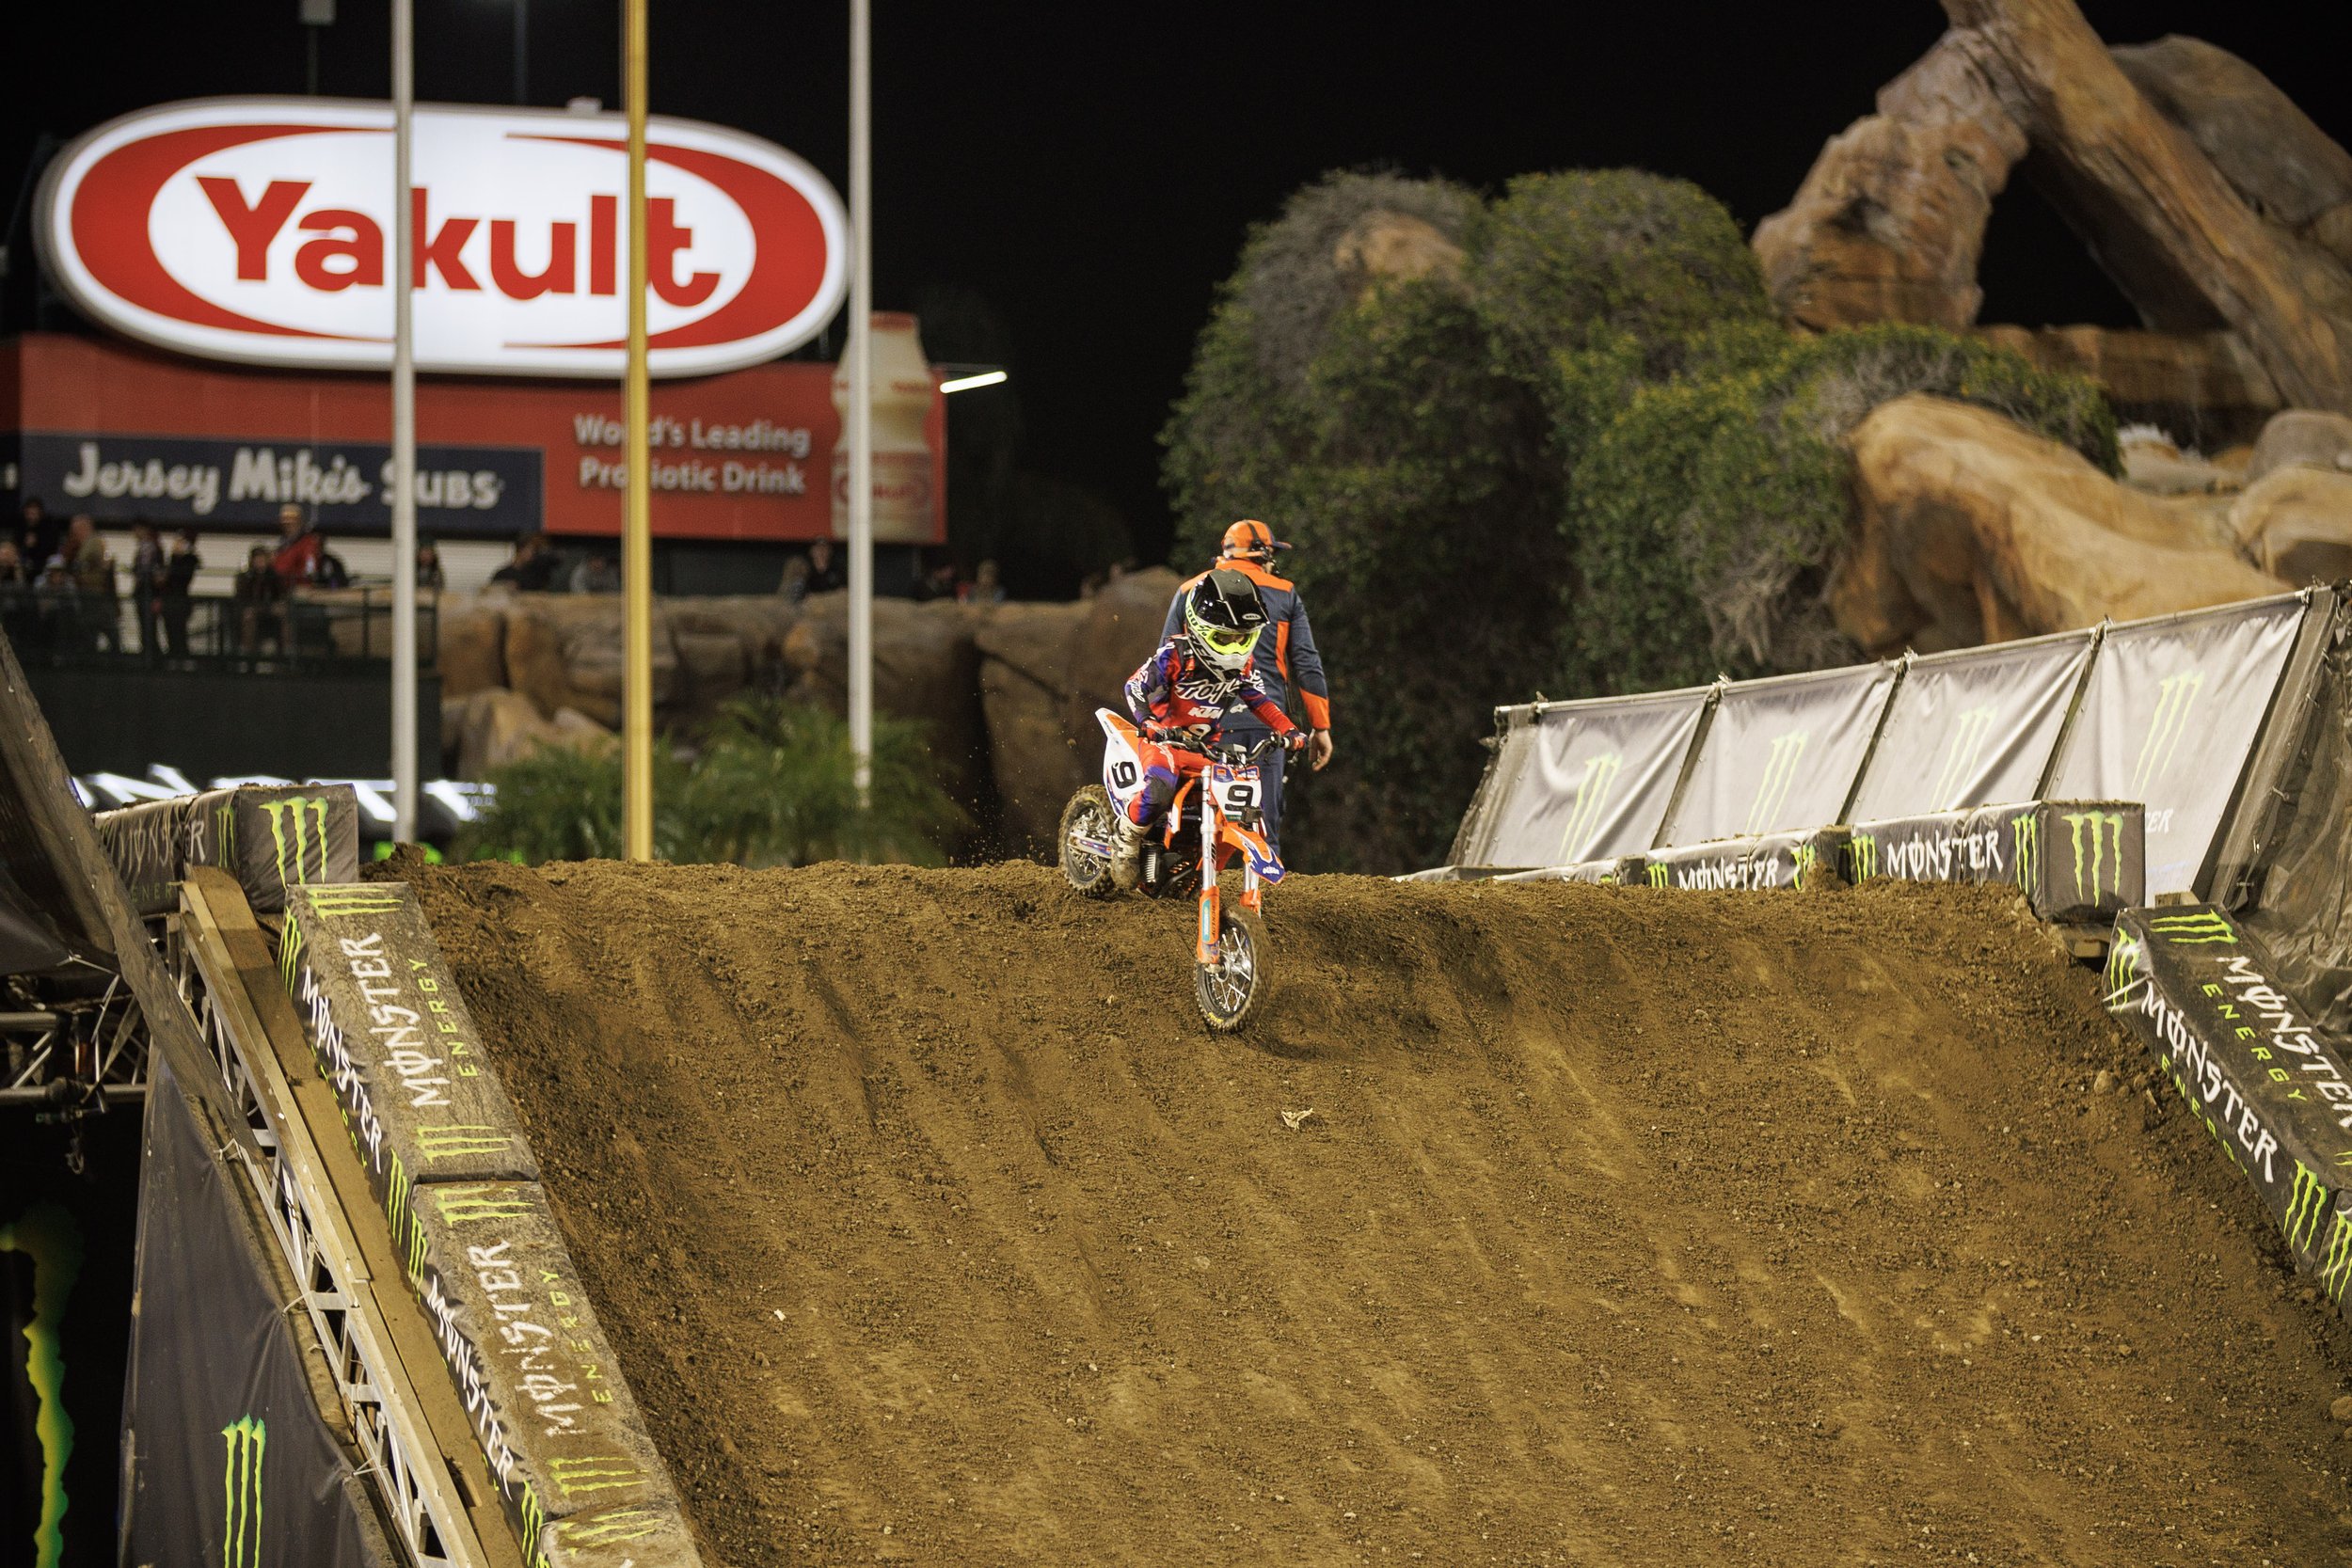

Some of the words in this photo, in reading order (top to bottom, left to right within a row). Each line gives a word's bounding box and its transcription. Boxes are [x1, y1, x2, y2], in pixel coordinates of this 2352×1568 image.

[196, 176, 721, 308] Yakult
[573, 414, 685, 448] Wod's
[691, 419, 812, 459] Leading
[64, 442, 220, 515] Jersey
[229, 447, 372, 503] Mike's
[580, 456, 716, 492] Proiotic
[722, 460, 804, 494] Drink
[1187, 609, 1210, 636] 00%
[1188, 705, 1224, 720] KTM
[1111, 761, 1137, 789] 9
[1224, 784, 1254, 812] 9
[407, 958, 479, 1077] ENERGY
[2202, 983, 2307, 1101] ENERGY
[538, 1269, 613, 1403] ENERGY
